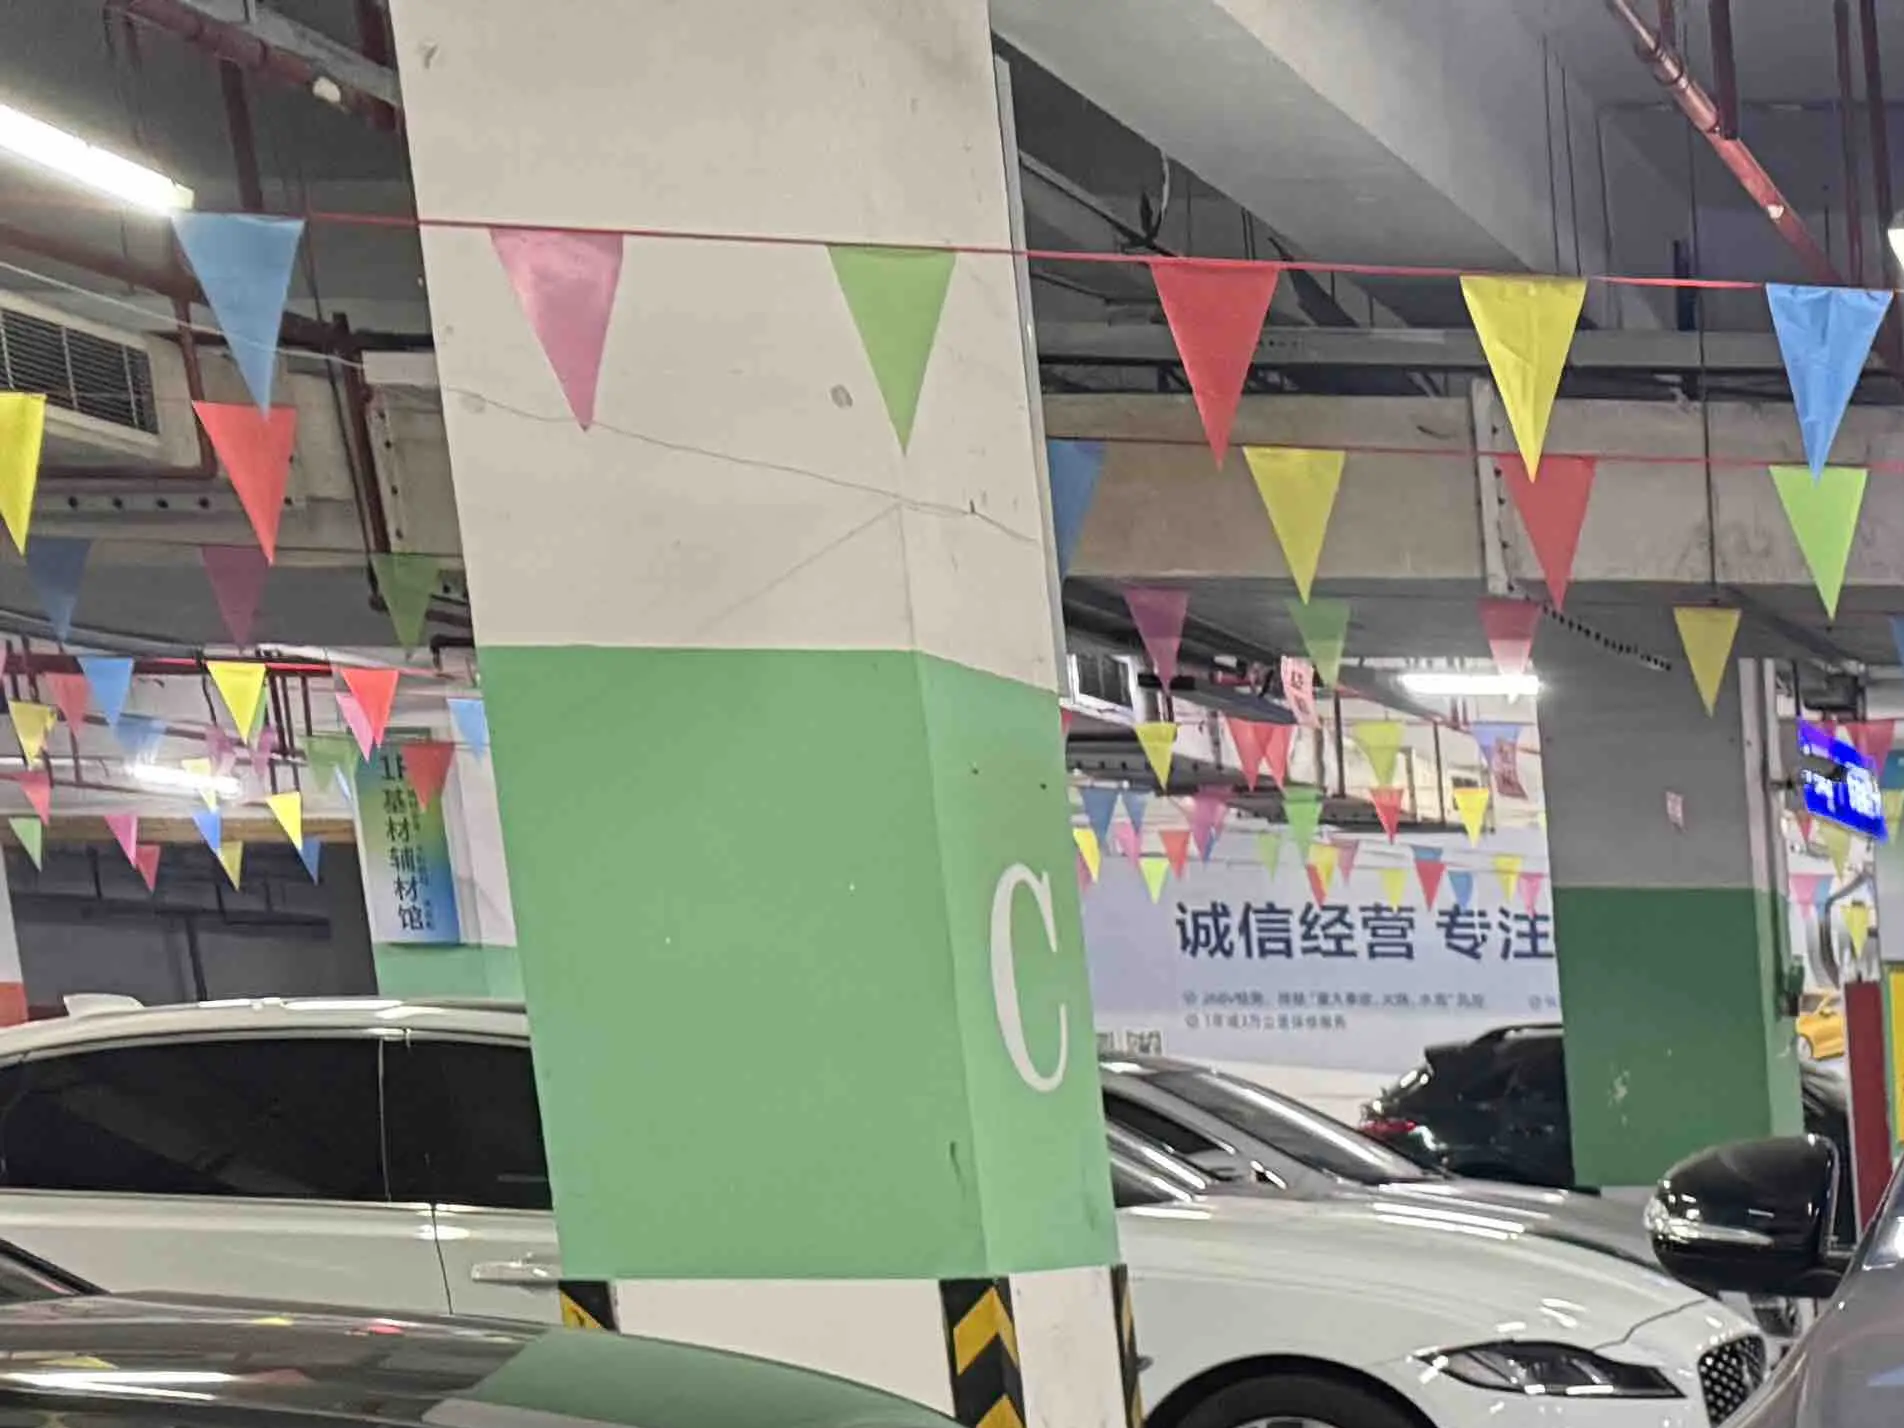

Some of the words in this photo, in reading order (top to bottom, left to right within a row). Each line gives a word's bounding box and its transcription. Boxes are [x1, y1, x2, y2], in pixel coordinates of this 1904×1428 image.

[990, 862, 1068, 1093] C
[1175, 902, 1416, 961] 诚信经营
[1436, 908, 1555, 962] 专注
